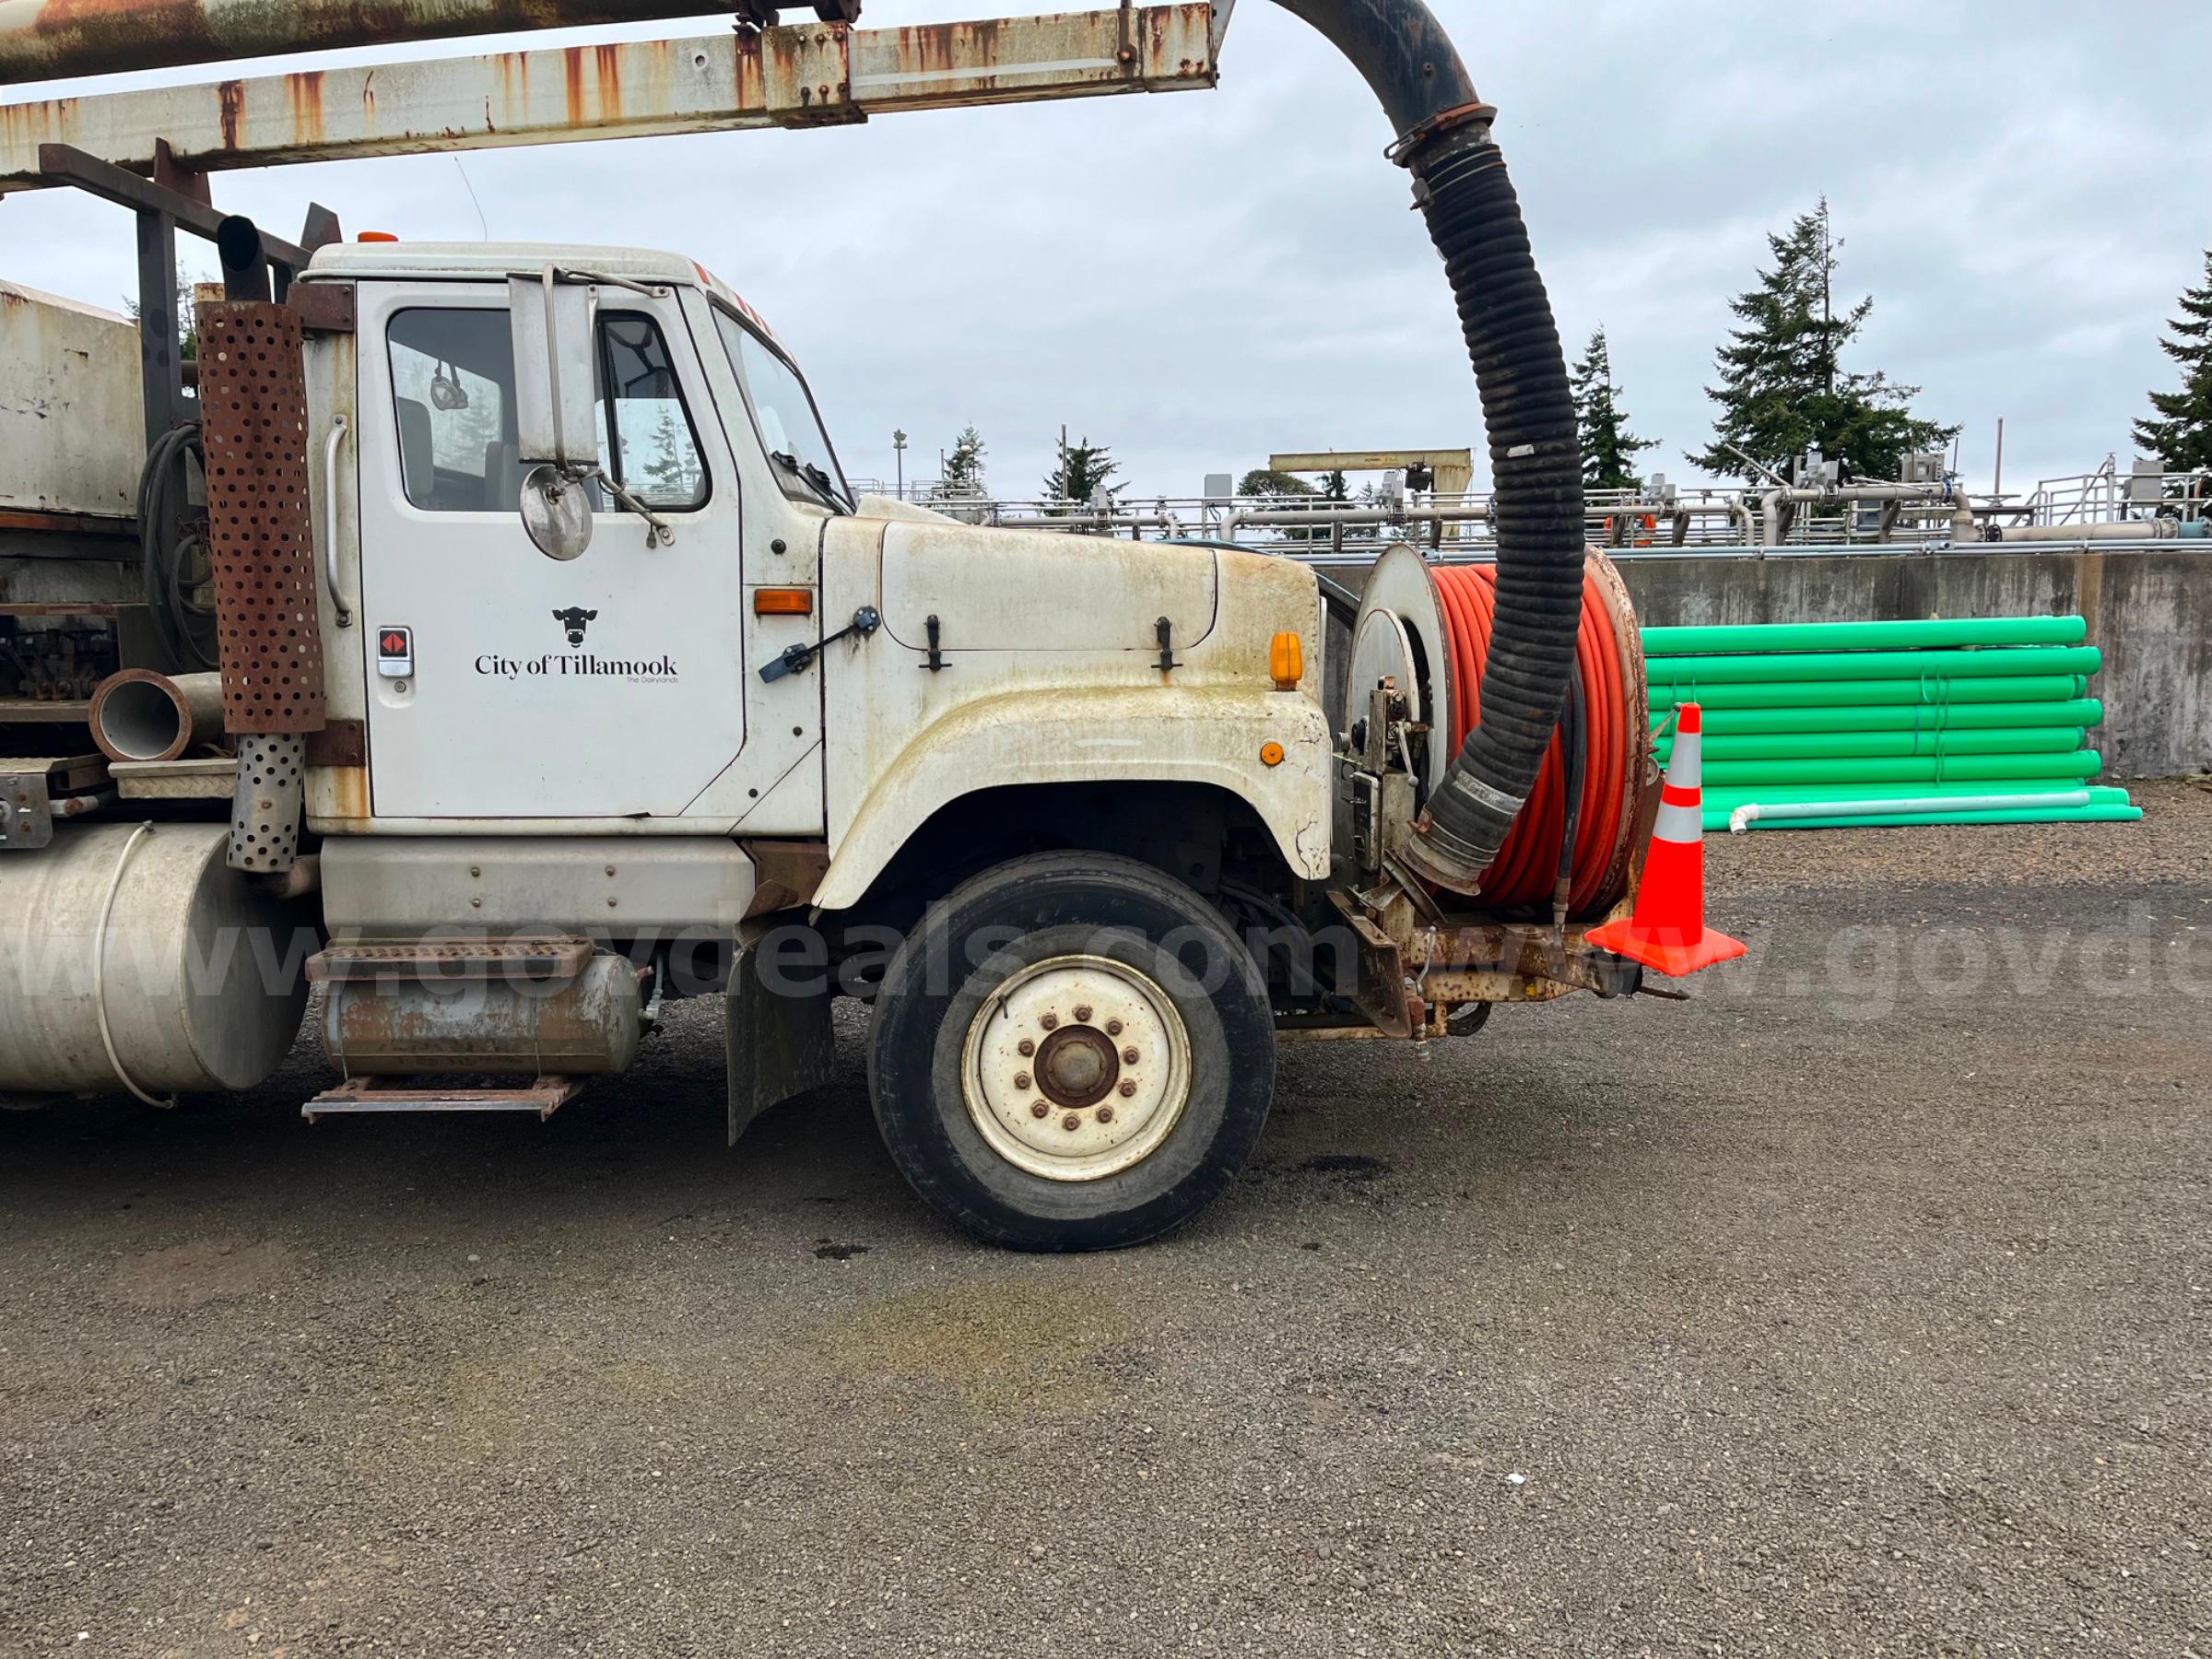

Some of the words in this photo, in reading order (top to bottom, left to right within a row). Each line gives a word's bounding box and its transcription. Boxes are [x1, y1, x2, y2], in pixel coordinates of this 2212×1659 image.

[475, 654, 522, 680] City
[526, 654, 552, 675] of
[554, 654, 678, 675] Tillamook
